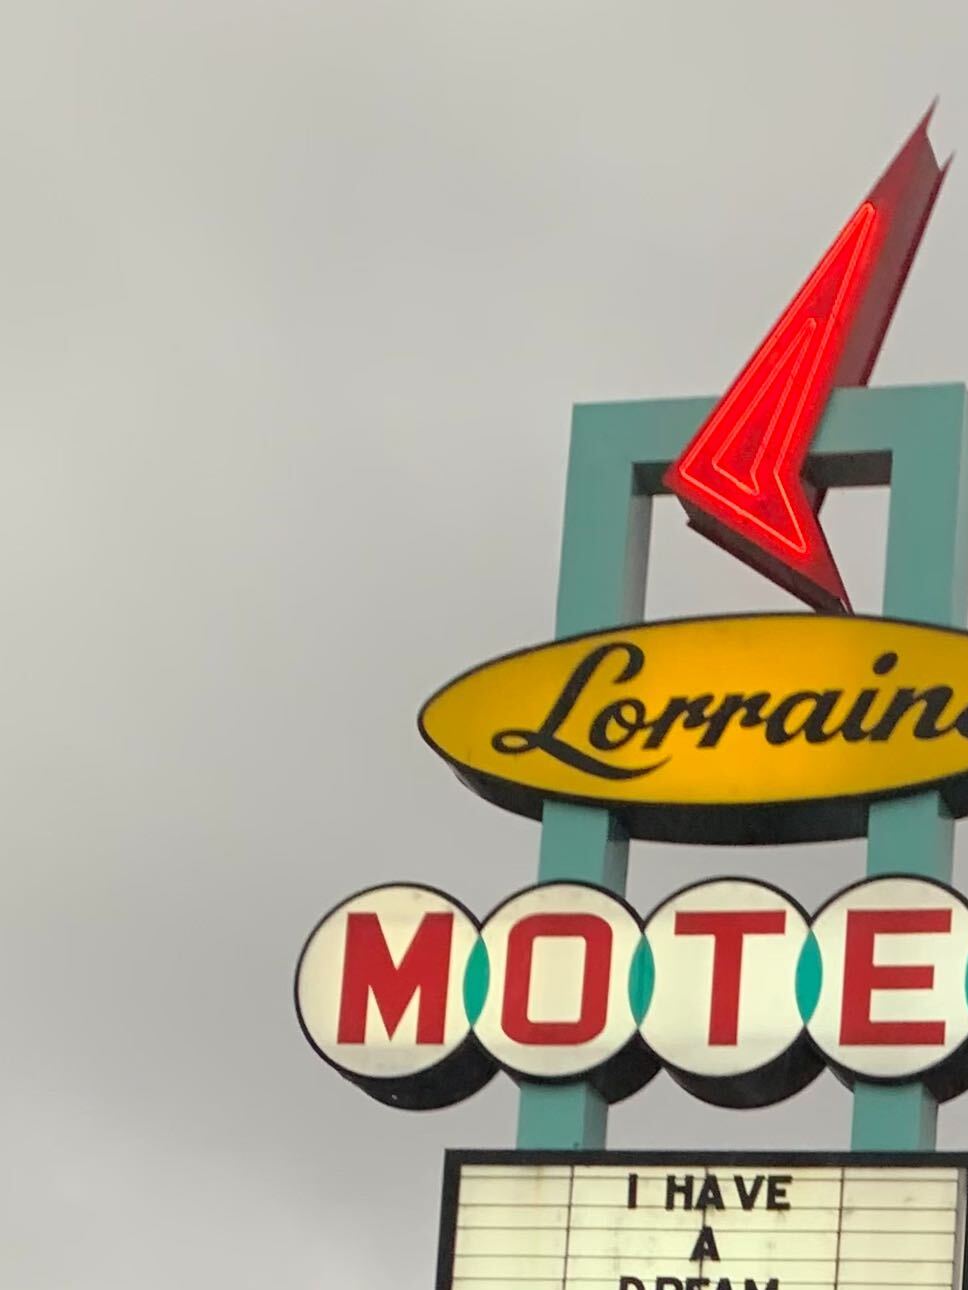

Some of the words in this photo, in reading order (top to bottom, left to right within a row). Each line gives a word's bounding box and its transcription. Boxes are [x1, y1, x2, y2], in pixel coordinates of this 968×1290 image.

[628, 1174, 637, 1209] I
[666, 1175, 792, 1211] HAVE
[689, 1226, 721, 1262] A
